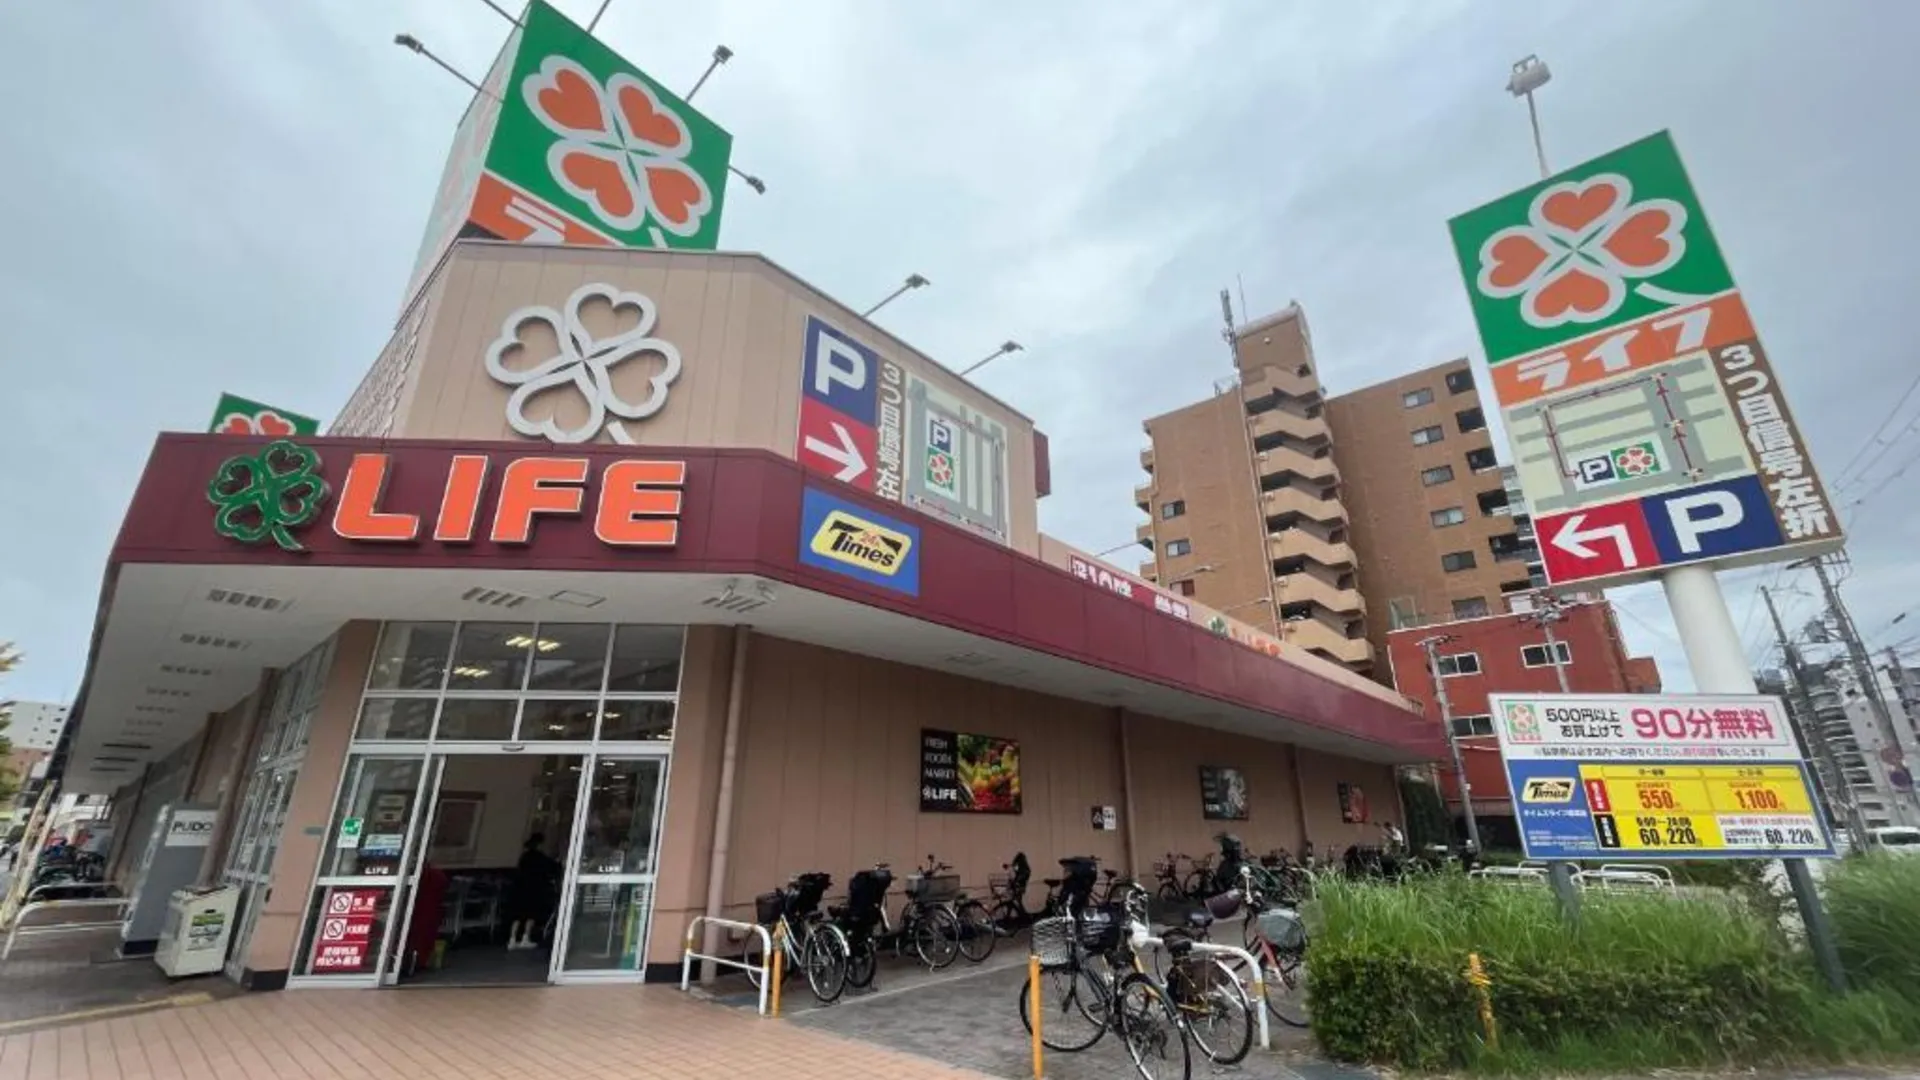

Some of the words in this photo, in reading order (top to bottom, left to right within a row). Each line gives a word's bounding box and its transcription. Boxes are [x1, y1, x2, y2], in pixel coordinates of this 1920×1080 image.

[815, 330, 866, 396] P
[1516, 307, 1713, 391] ライフ
[932, 424, 949, 445] P
[1720, 344, 1831, 539] 3つ目信号左折
[1582, 458, 1609, 481] P
[332, 453, 686, 547] LIFE
[1664, 491, 1744, 553] P
[828, 519, 903, 567] Times
[1545, 708, 1620, 723] 500円以上
[1560, 724, 1624, 738] お買上げで
[1631, 708, 1775, 739] 90分無料
[932, 788, 957, 800] LIFE
